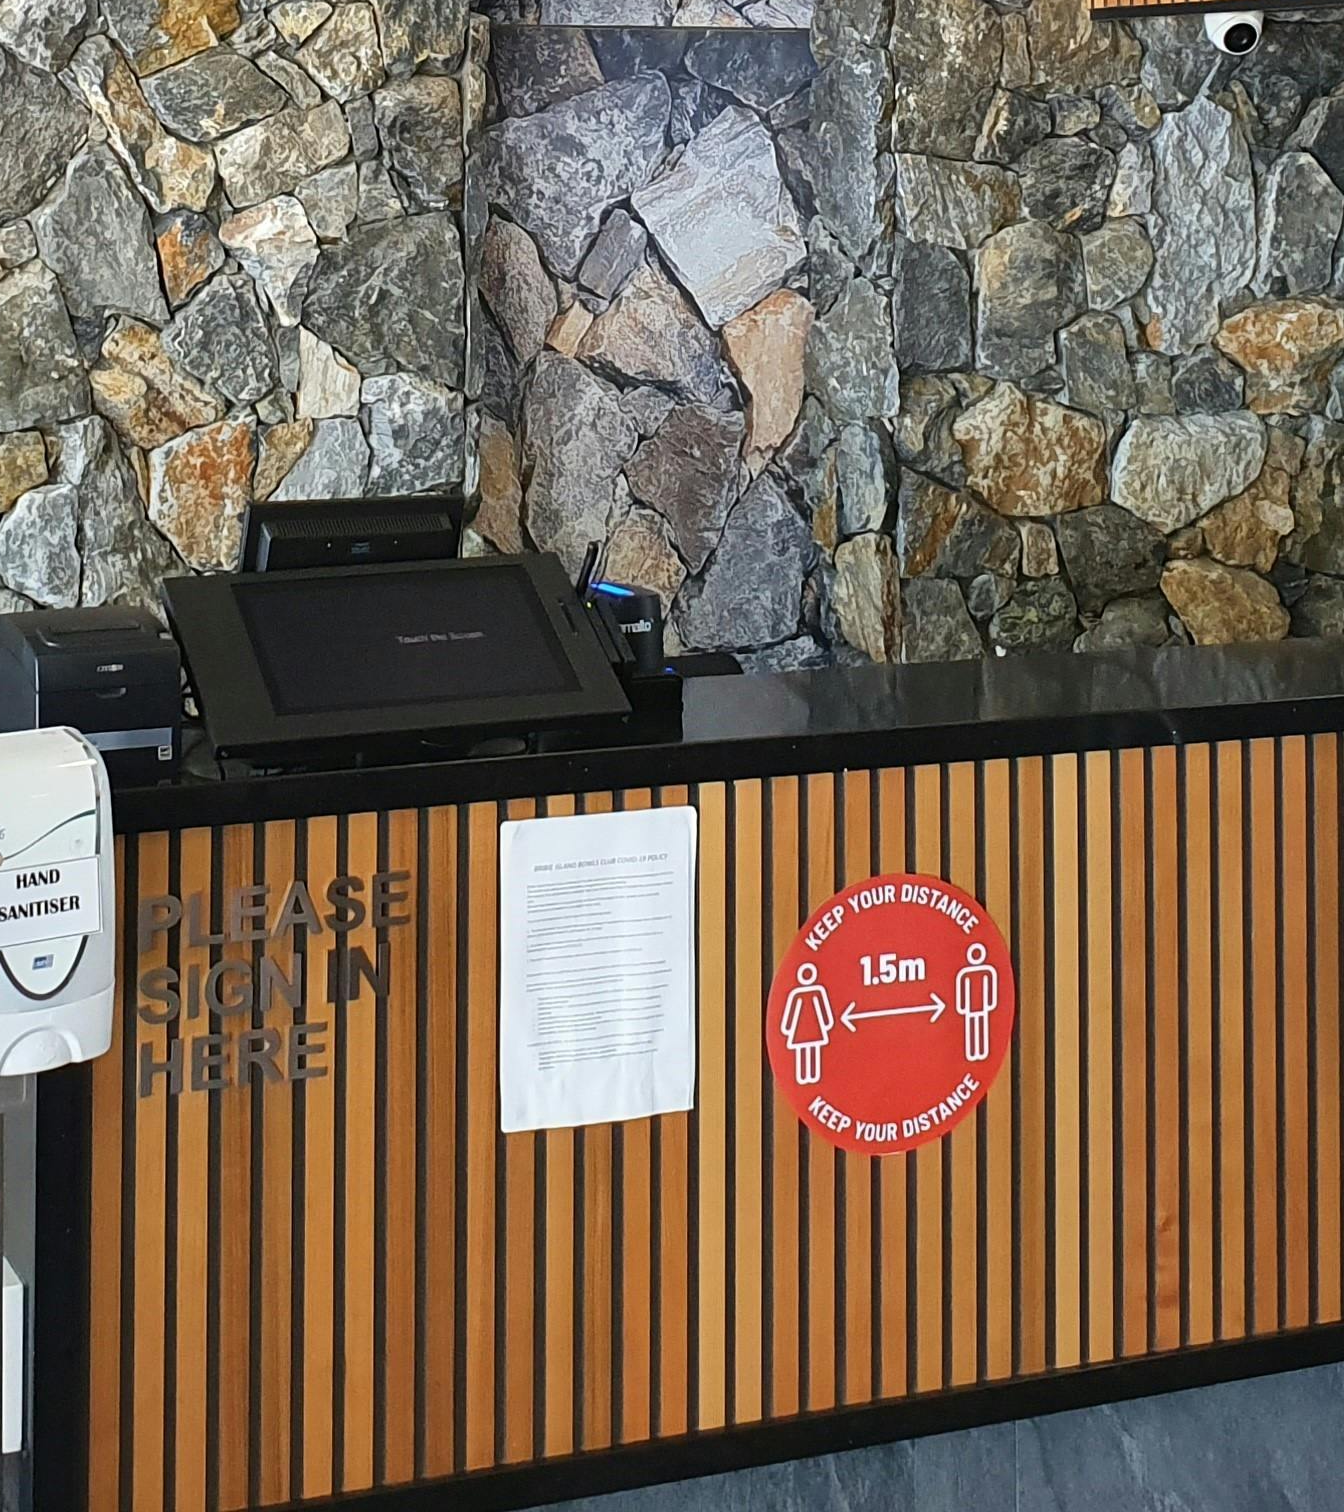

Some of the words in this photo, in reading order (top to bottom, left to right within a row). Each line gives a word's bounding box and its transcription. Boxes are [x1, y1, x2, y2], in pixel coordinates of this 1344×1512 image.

[16, 868, 60, 889] HAND
[137, 870, 411, 954] PLEASE
[805, 904, 844, 951] KEEP
[848, 884, 896, 914] YOUR
[901, 883, 979, 935] DISTANCE
[138, 952, 303, 1024] SIGN
[327, 941, 391, 1004] IN
[859, 952, 926, 986] 1.5m
[140, 1021, 328, 1098] HERE
[808, 1096, 851, 1133] KEEP
[855, 1120, 898, 1142] YOUR
[902, 1073, 980, 1138] DISTANCE
